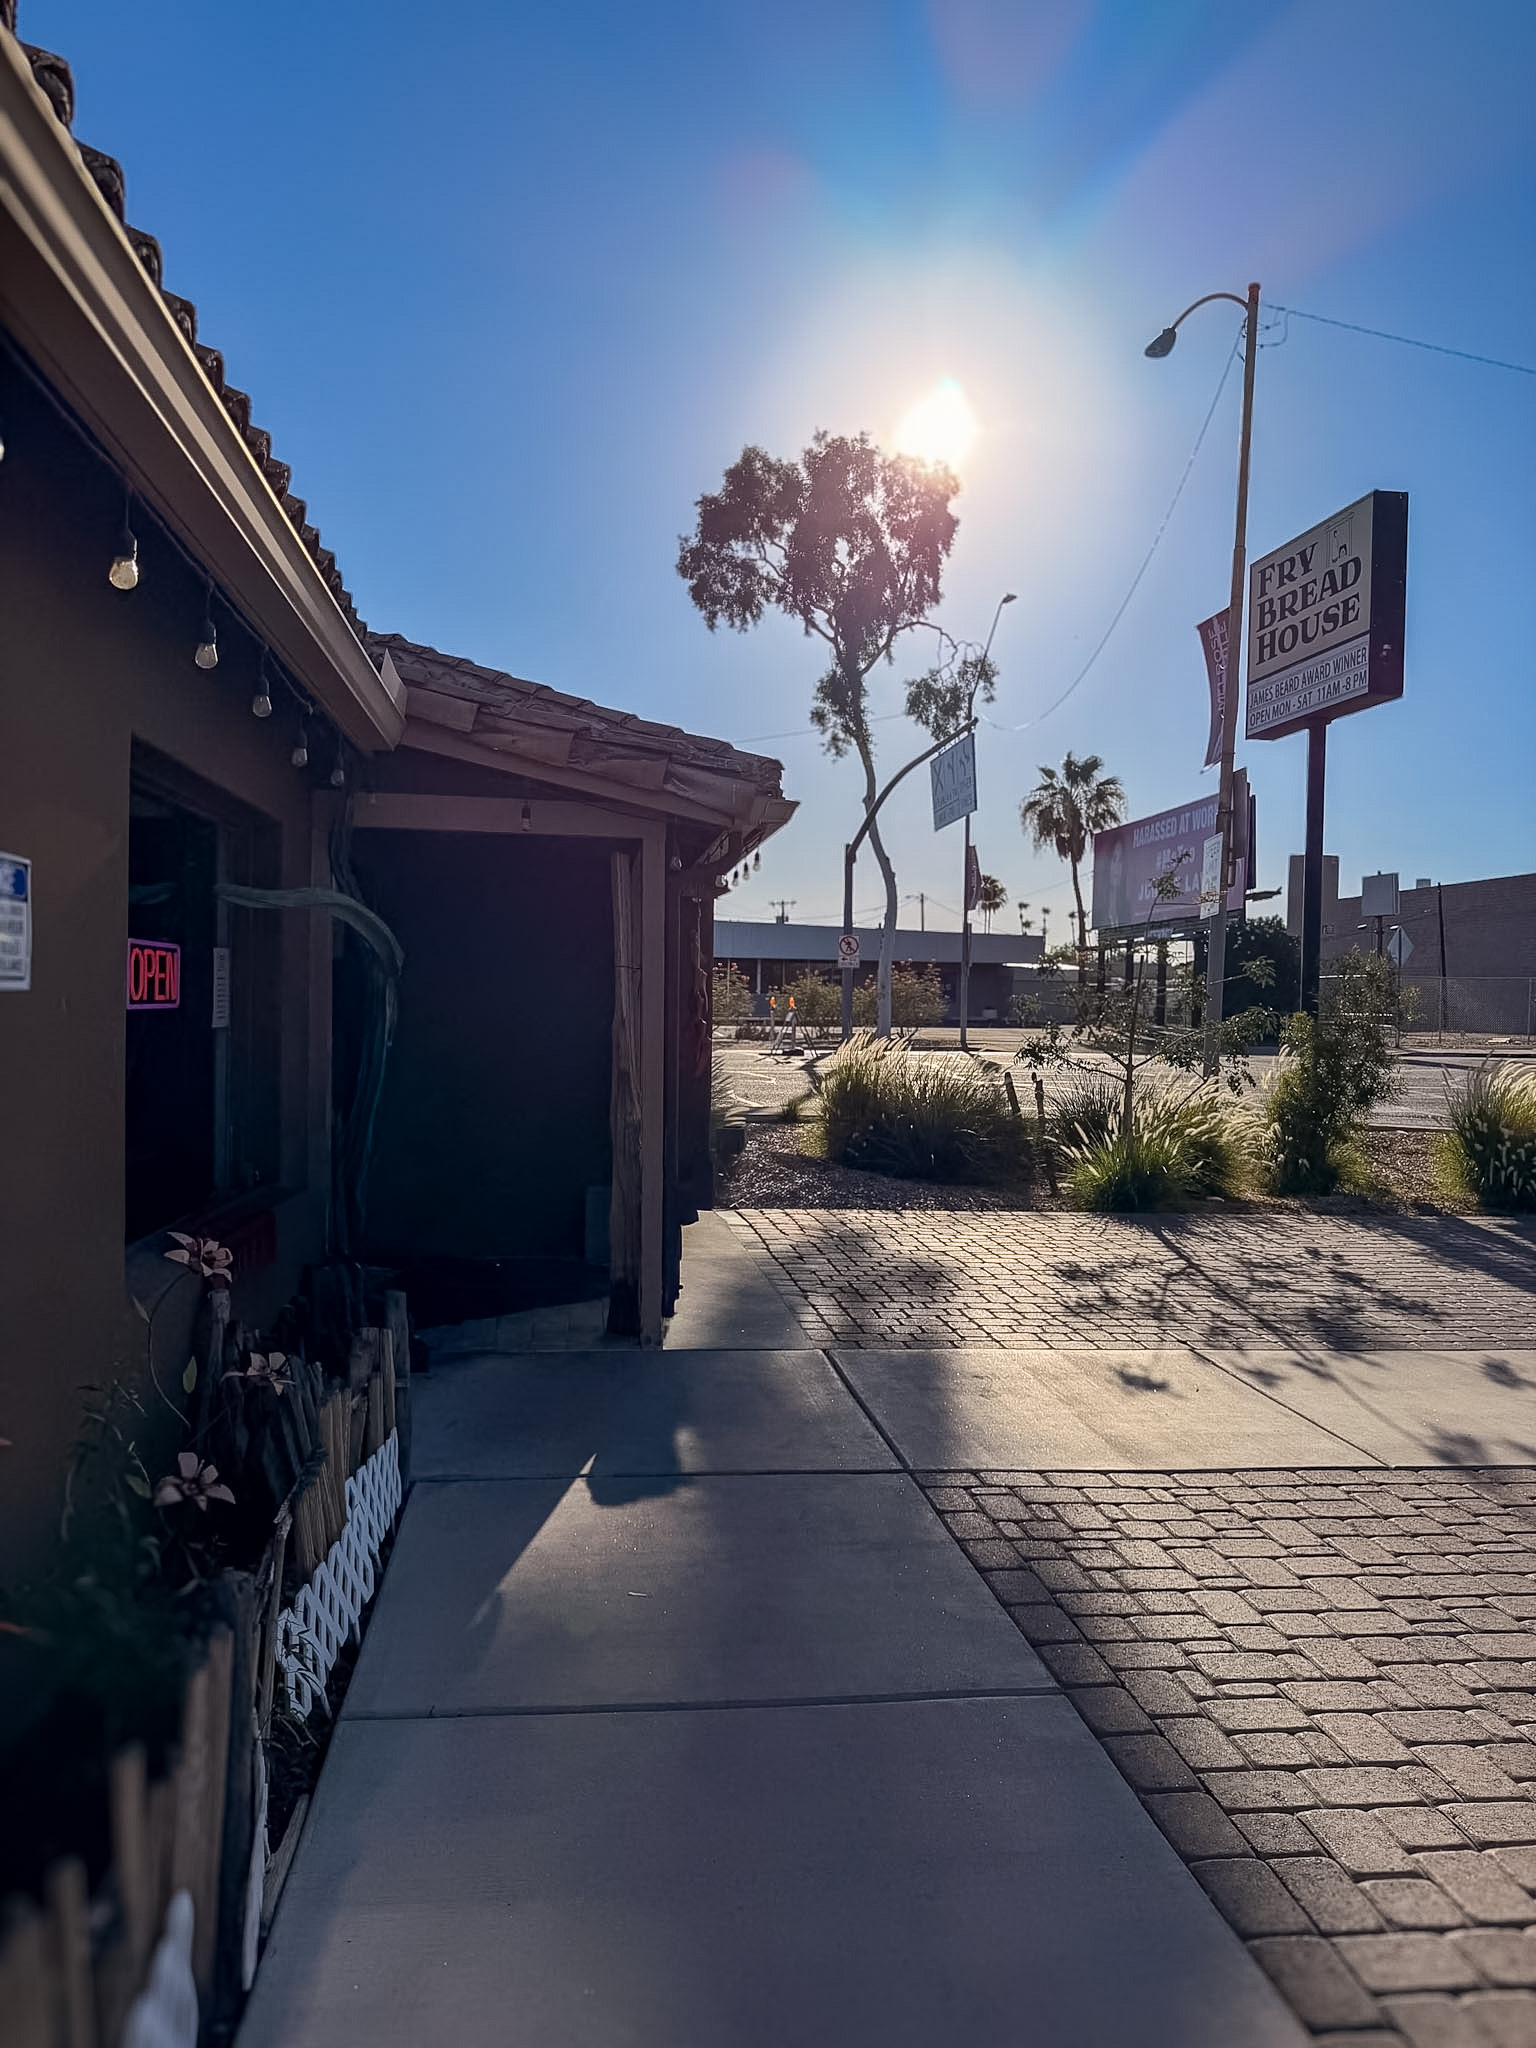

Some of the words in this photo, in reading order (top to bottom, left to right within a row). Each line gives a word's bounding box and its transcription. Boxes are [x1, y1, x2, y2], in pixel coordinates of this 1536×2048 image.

[1256, 557, 1362, 633] BREAD
[1257, 541, 1318, 600] FRY
[1256, 592, 1360, 666] HOUSE
[1249, 686, 1273, 709] JAMES
[1275, 676, 1300, 697] BEARD
[1301, 662, 1331, 688] AWARD
[1332, 647, 1368, 675] WINNER
[1249, 707, 1271, 727] OPEN
[1272, 699, 1291, 719] MON
[1297, 691, 1313, 710] SAT
[1317, 679, 1341, 701] 11AM
[1178, 812, 1191, 834] AT
[130, 947, 178, 1001] OPEN
